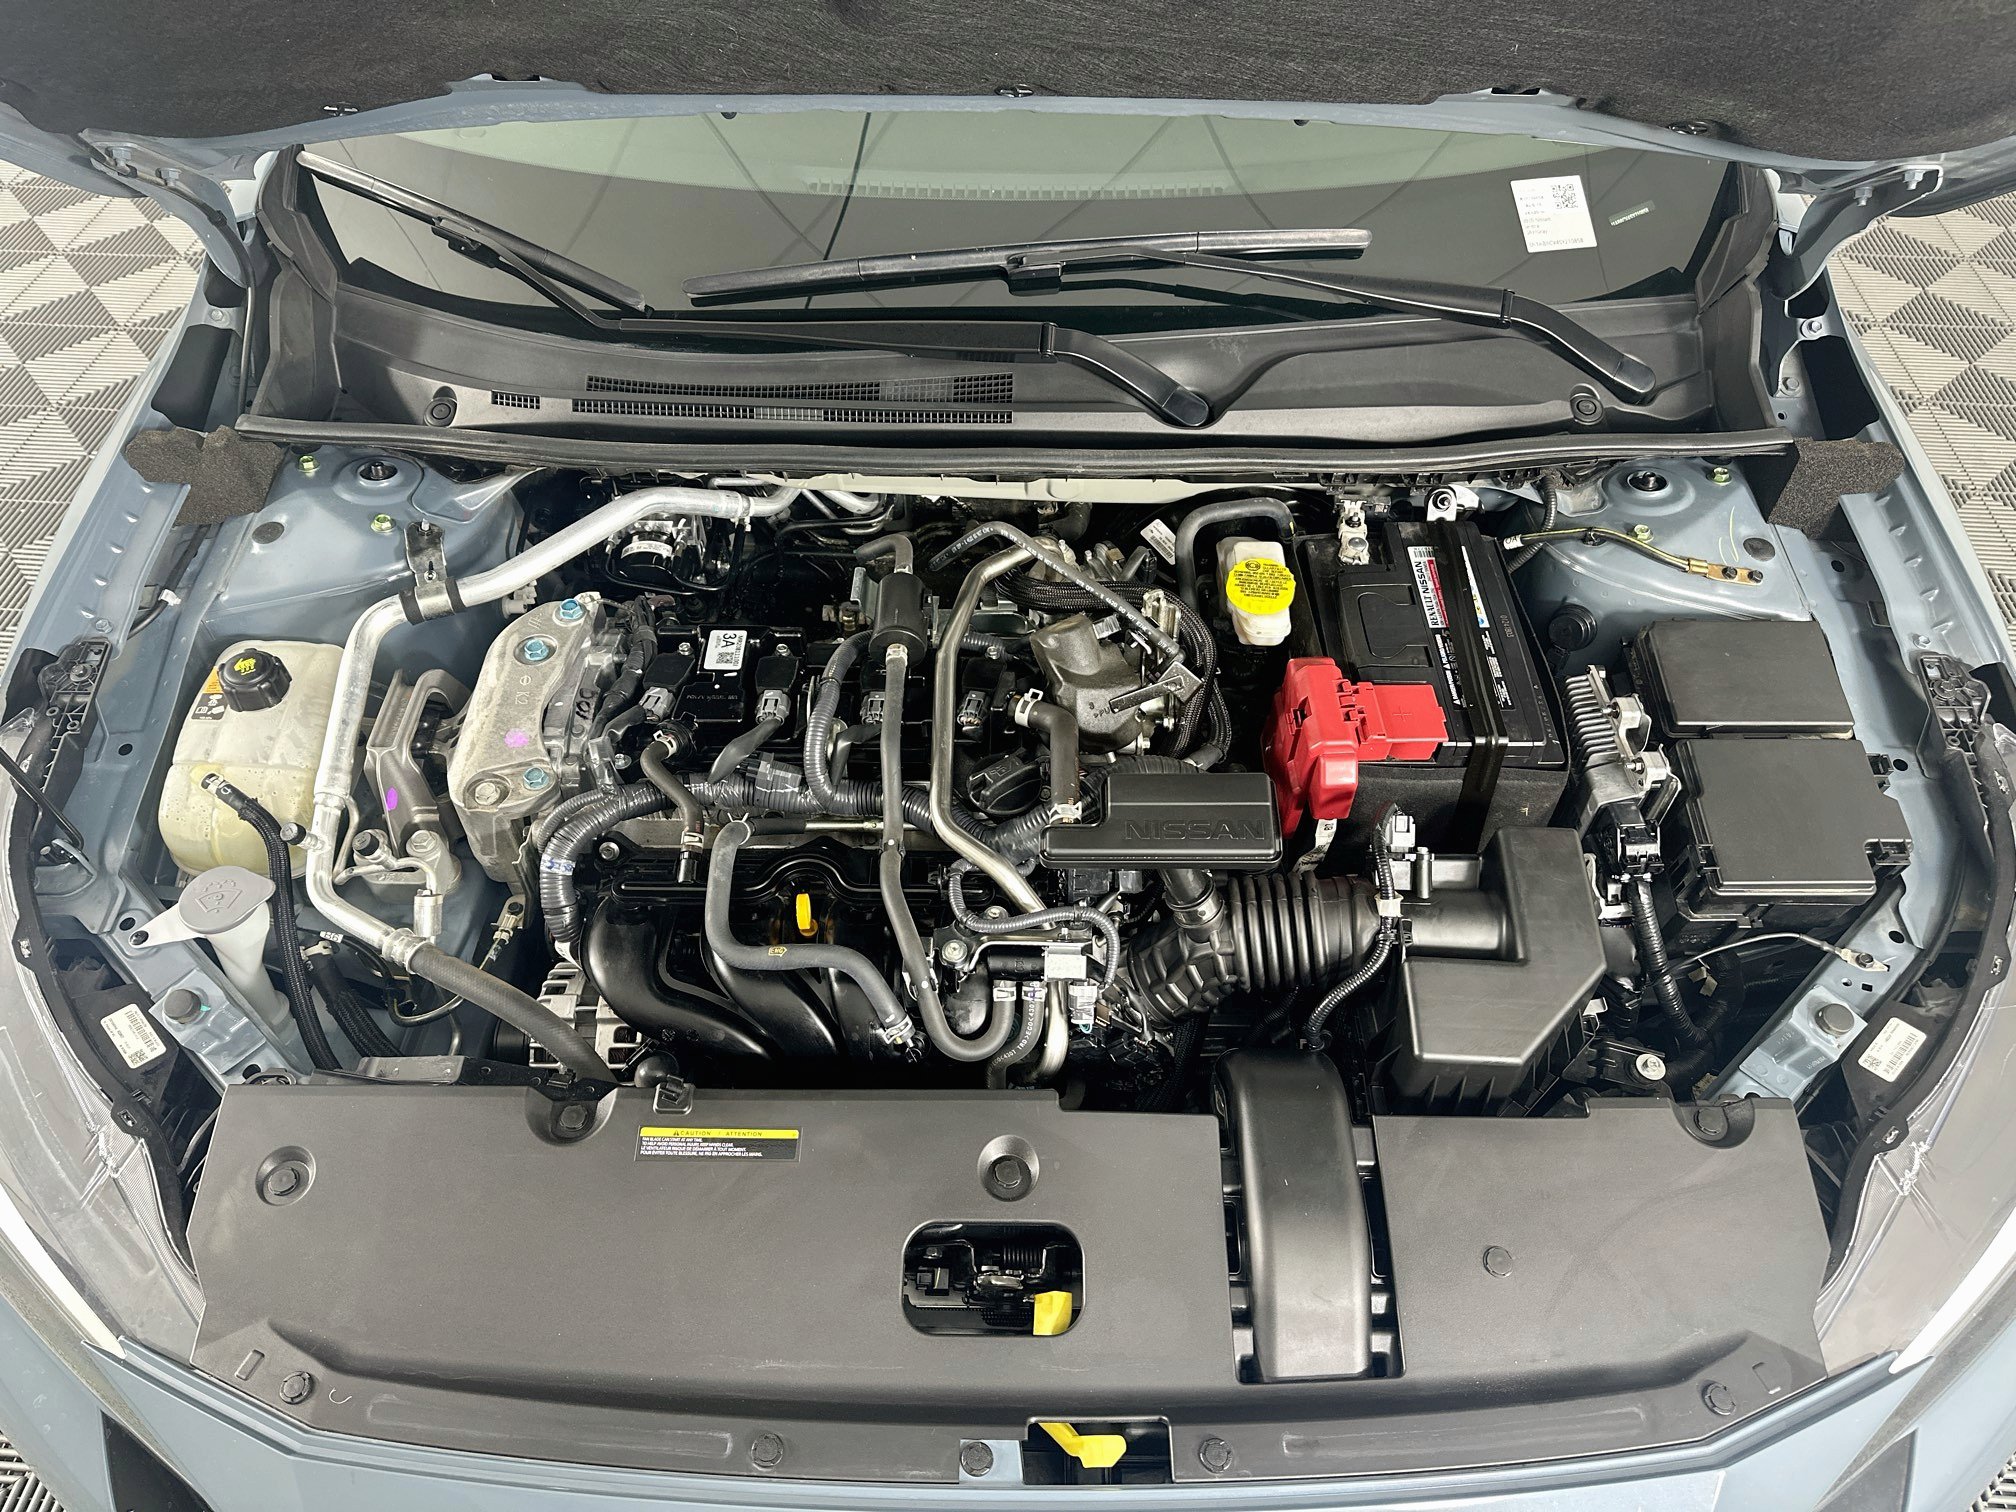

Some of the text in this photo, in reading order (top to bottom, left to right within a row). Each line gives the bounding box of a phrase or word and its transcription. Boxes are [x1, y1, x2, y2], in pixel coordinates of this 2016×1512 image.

[1414, 561, 1430, 594] NISSAN
[1423, 595, 1440, 627] RENAULT
[721, 633, 737, 648] 3A
[515, 691, 530, 705] K2
[1124, 819, 1266, 841] NISSAN
